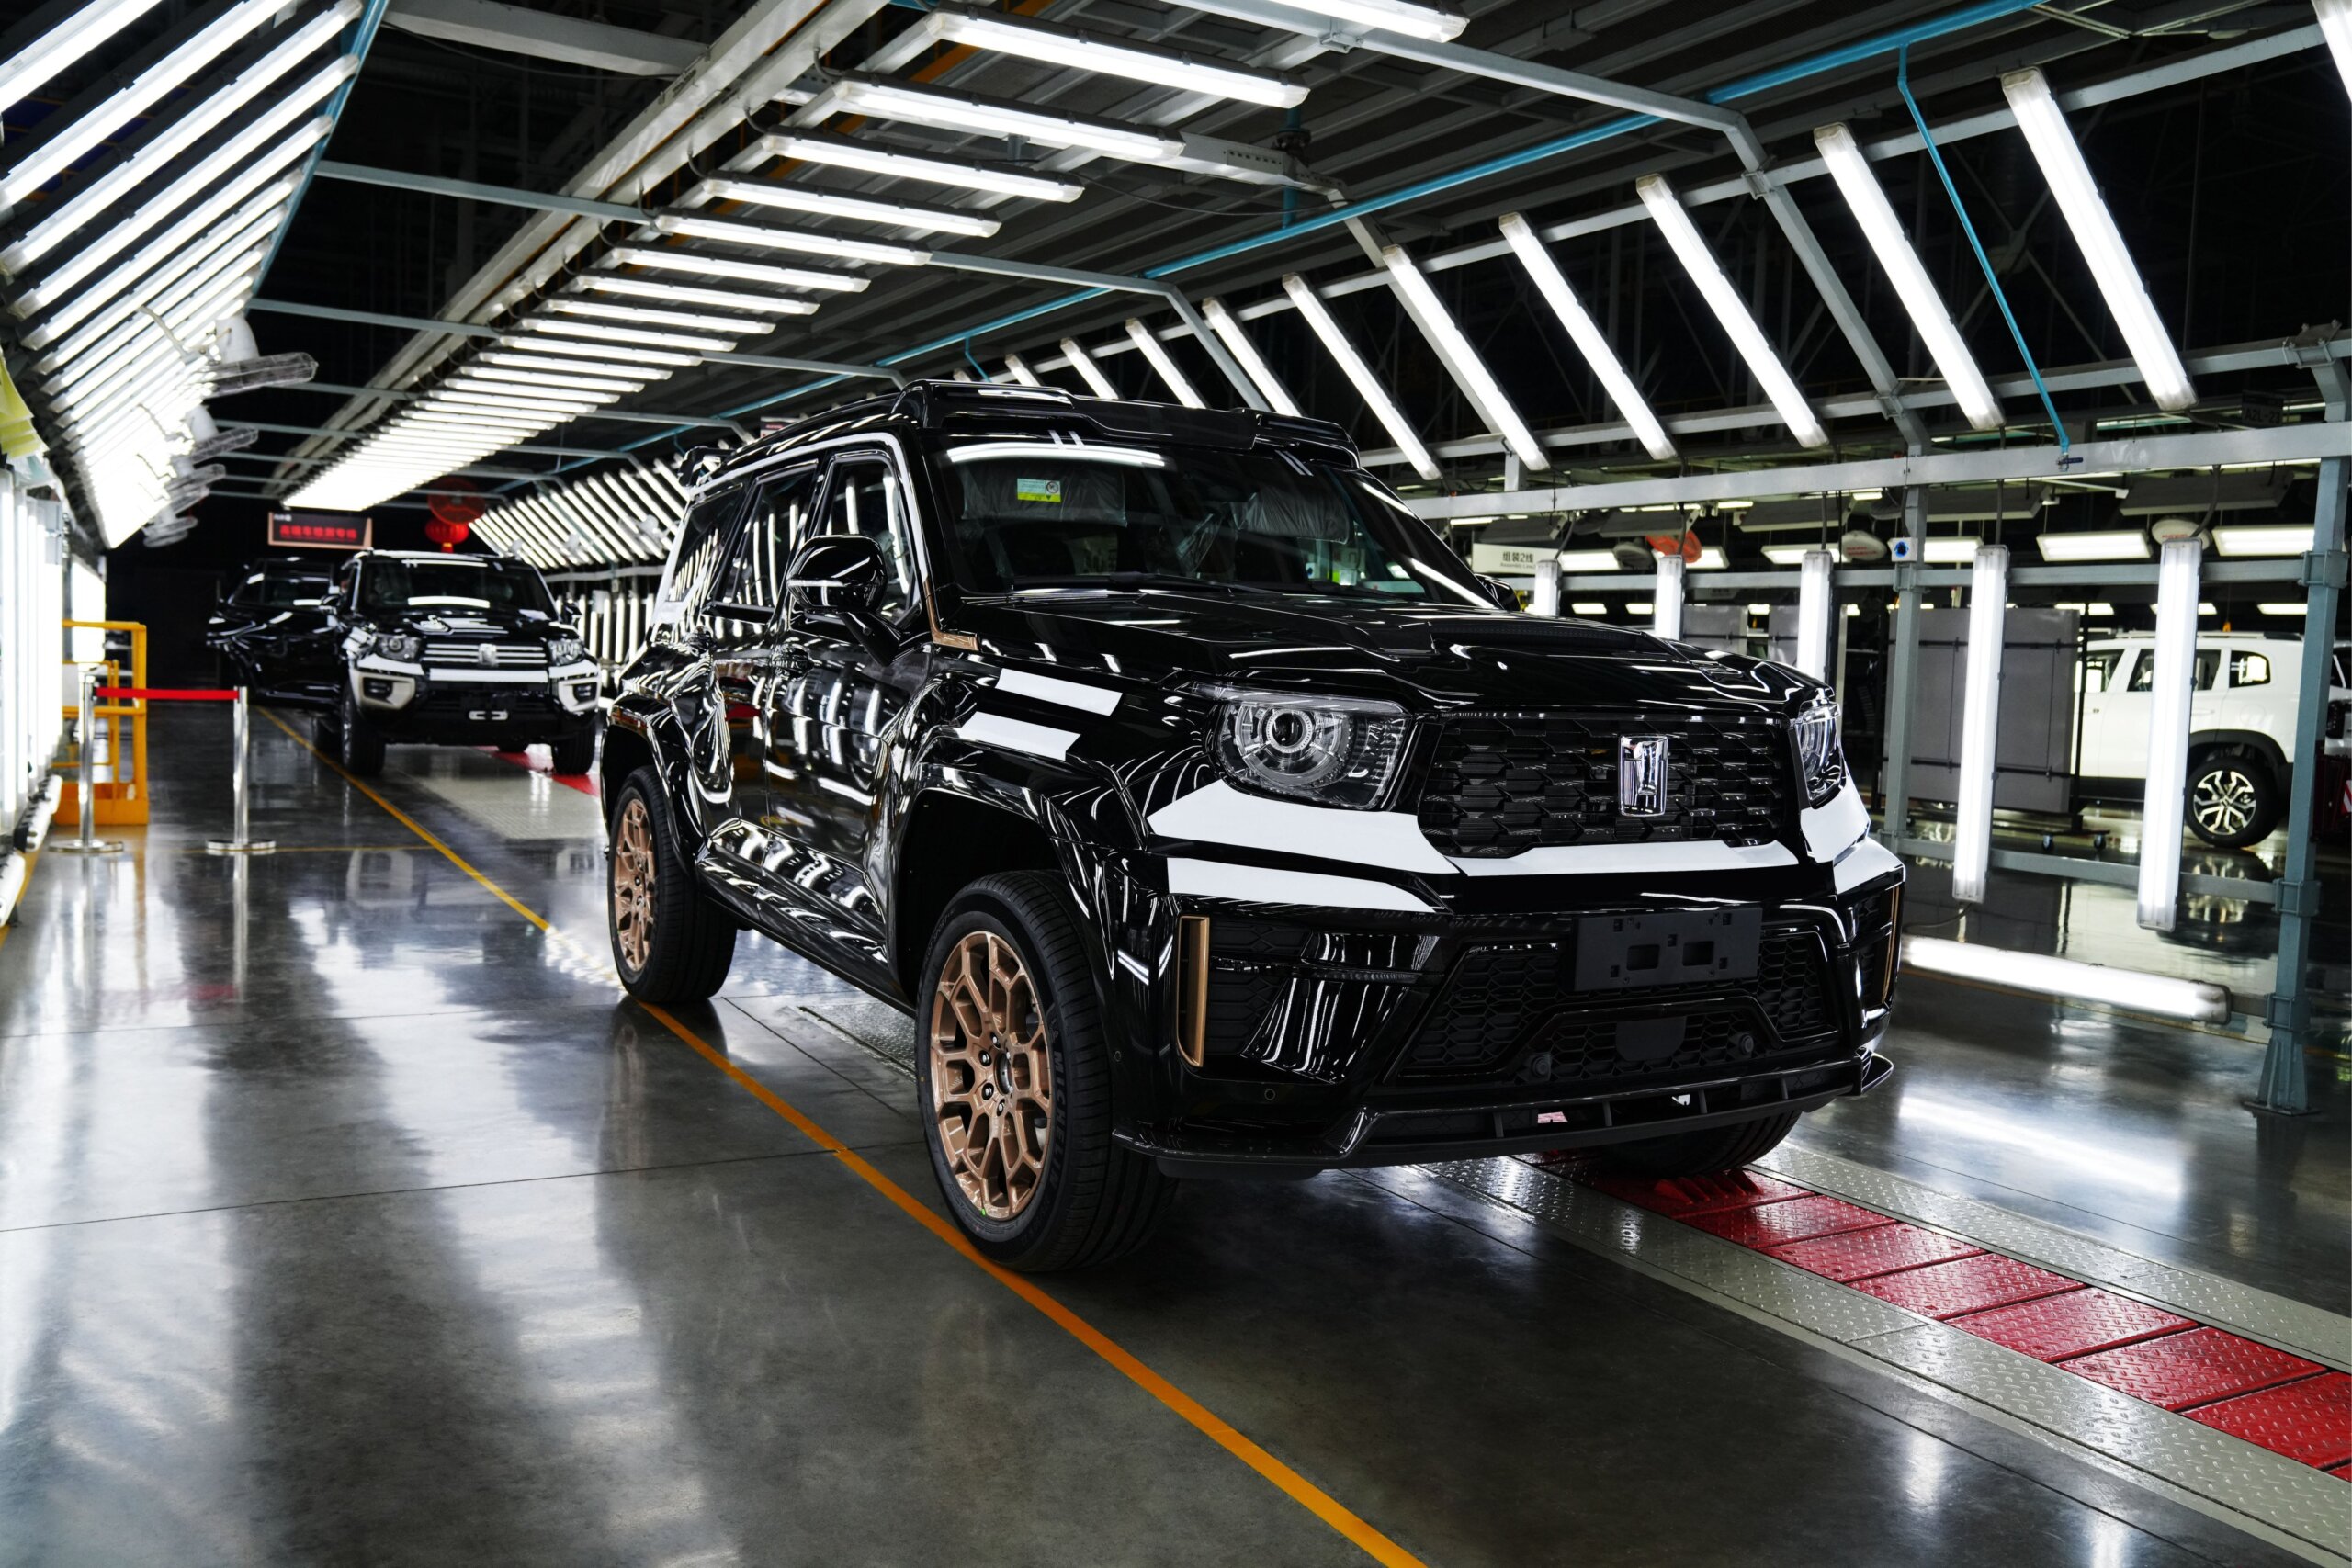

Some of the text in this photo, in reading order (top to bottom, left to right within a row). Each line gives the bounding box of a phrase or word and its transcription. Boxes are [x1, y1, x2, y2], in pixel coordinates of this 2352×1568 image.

[1502, 551, 1533, 563] 组装2线
[1048, 1051, 1066, 1188] MICHELIN
